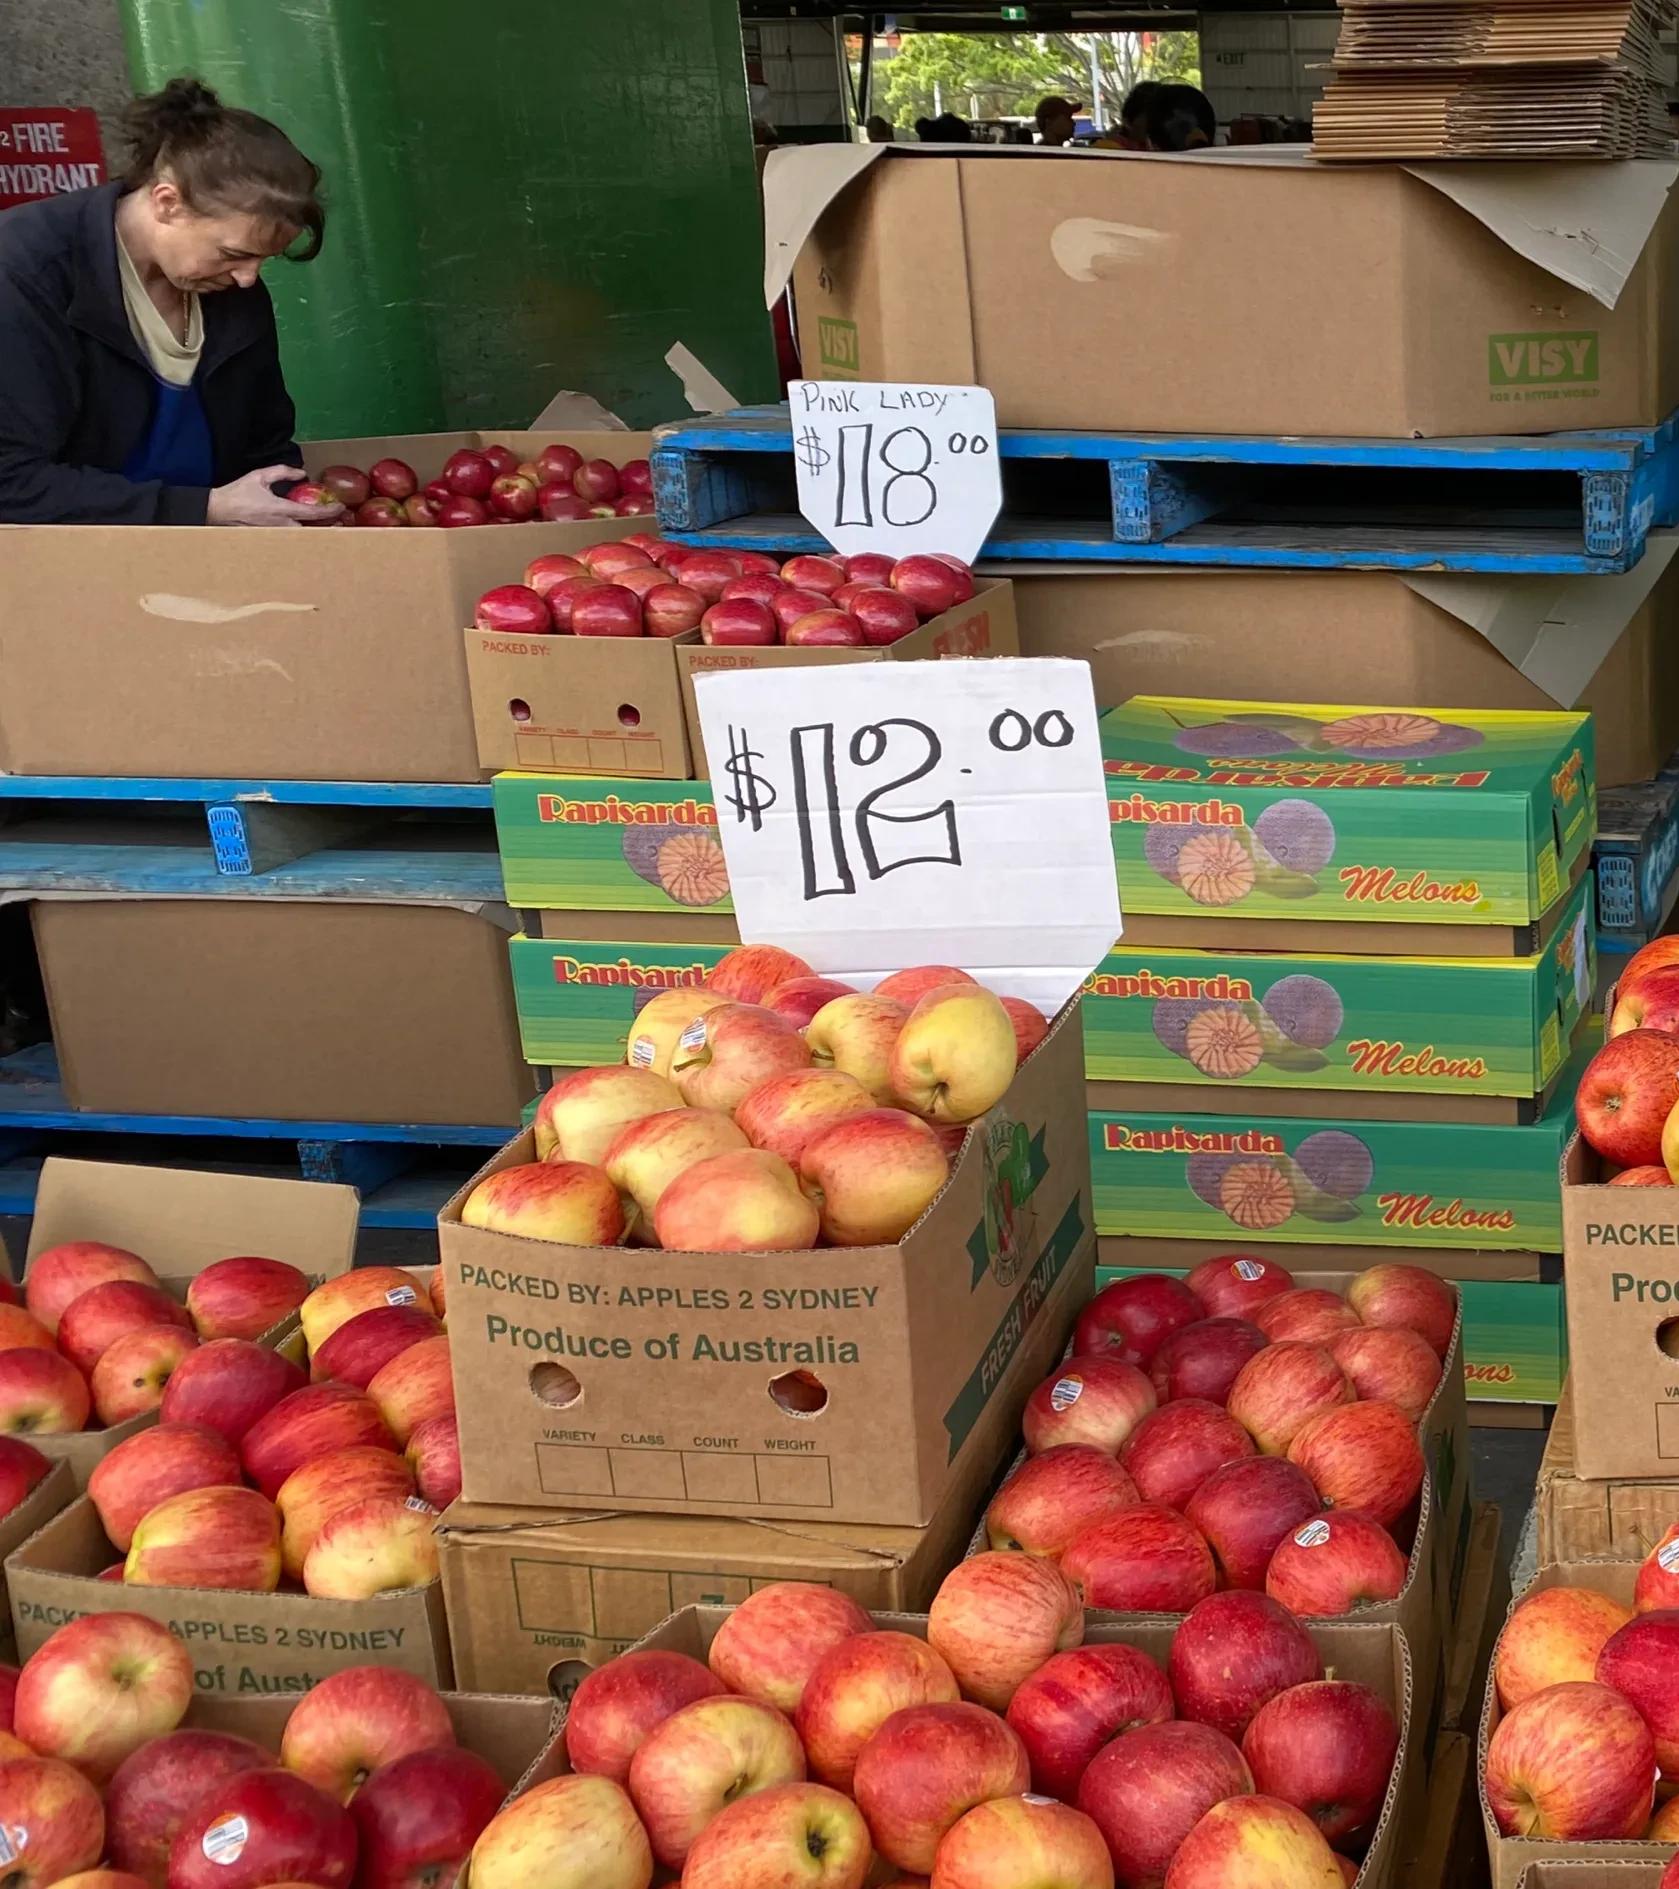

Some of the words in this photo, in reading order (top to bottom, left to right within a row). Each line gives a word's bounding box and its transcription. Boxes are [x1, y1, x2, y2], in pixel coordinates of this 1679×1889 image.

[12, 122, 70, 152] FIRE
[819, 323, 858, 364] VISY
[1495, 339, 1592, 378] VISY
[801, 382, 860, 412] PINK
[880, 389, 949, 416] LADY
[482, 640, 528, 656] PACKED
[689, 655, 733, 668] PACKED
[538, 794, 717, 826] Rapisarda
[1109, 793, 1244, 827] pisarda
[1338, 865, 1483, 906] Melons
[552, 956, 716, 988] Rapisard
[1347, 1038, 1488, 1080] Melons
[1104, 1122, 1284, 1155] Rapisarda
[1377, 1192, 1516, 1232] Melons
[460, 1263, 559, 1301] PACKED
[617, 1286, 730, 1309] APPLES
[738, 1290, 754, 1310] 2
[762, 1286, 879, 1310] SYDNEY
[981, 1314, 1022, 1396] FRESH
[1024, 1245, 1057, 1319] FRUIT
[487, 1314, 632, 1360] Produce
[644, 1332, 680, 1361] of
[692, 1333, 861, 1364] Australia
[1464, 1361, 1515, 1384] ons
[542, 1428, 597, 1442] VARIETY
[620, 1433, 665, 1446] CLASS
[693, 1436, 739, 1449] COUNT
[764, 1439, 817, 1452] WEIGHT
[20, 1601, 90, 1625] PACK
[167, 1619, 267, 1645] APPLES
[275, 1627, 290, 1646] 2
[296, 1626, 407, 1651] SYDNEY
[533, 1633, 587, 1649] WEIGHT
[194, 1666, 225, 1690] of
